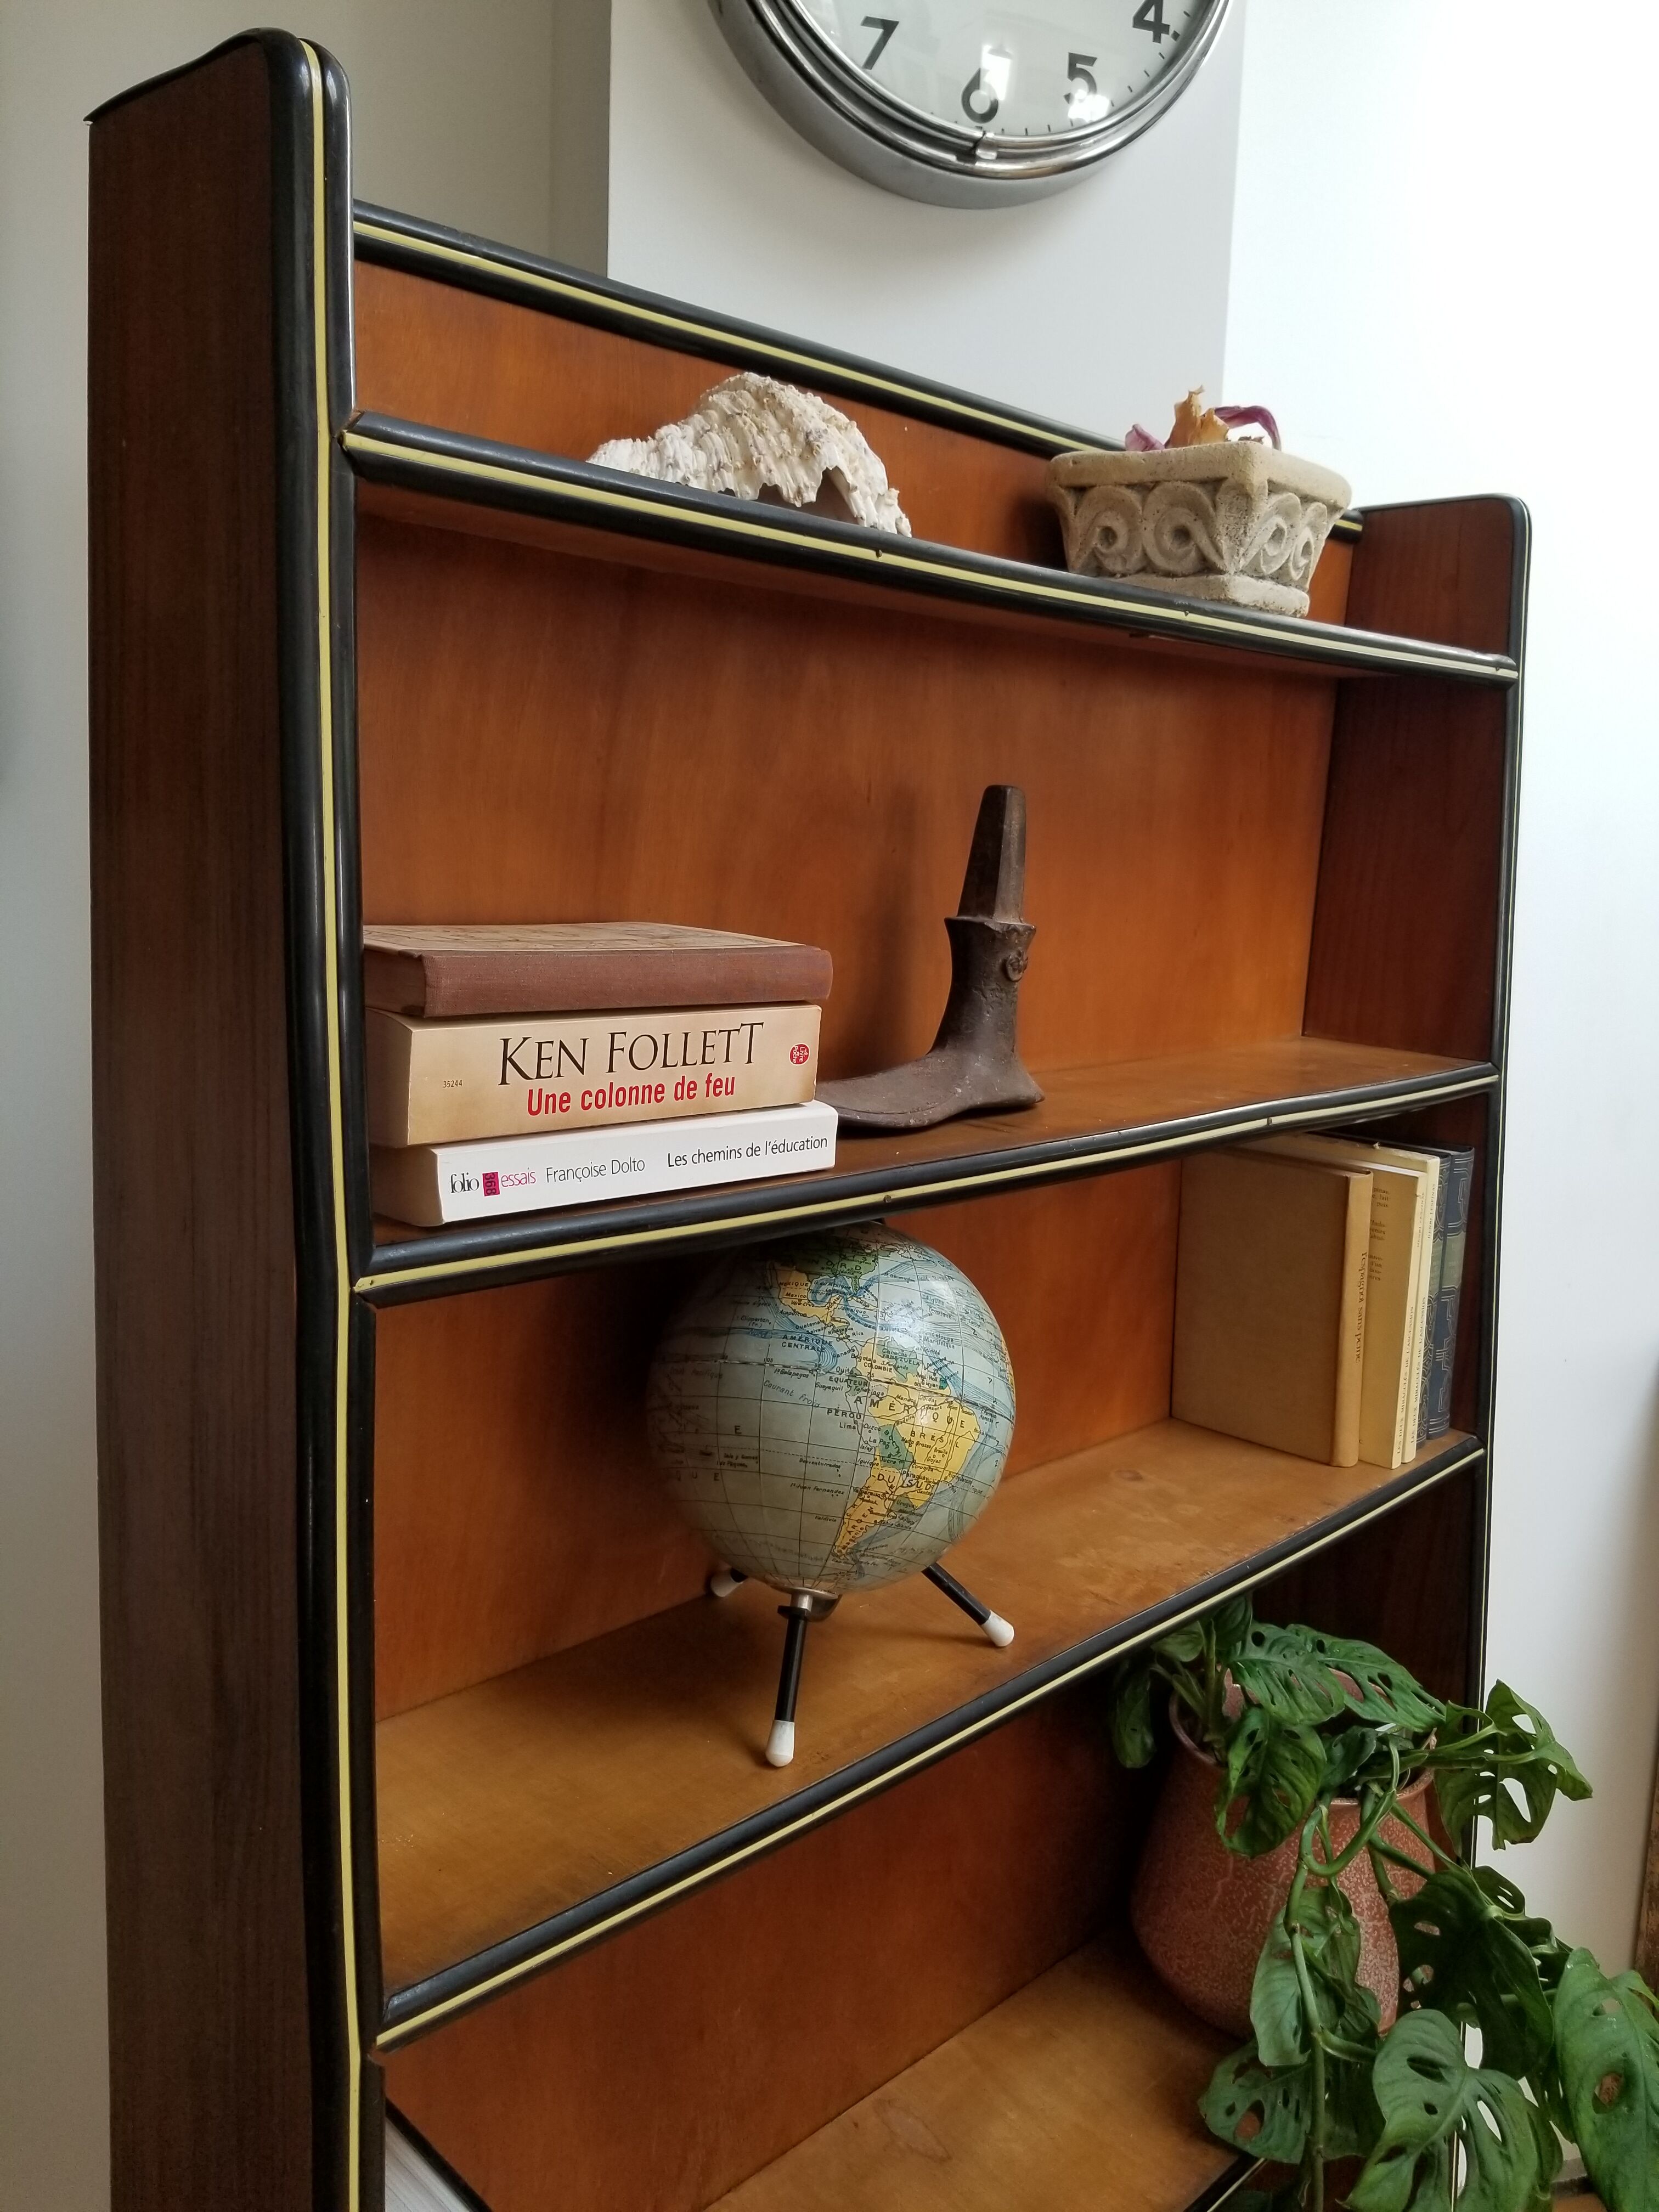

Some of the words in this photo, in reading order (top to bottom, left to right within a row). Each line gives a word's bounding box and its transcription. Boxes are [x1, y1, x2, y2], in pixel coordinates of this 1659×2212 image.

[1132, 0, 1170, 44] 4
[860, 15, 900, 70] 7
[1063, 52, 1098, 104] 5
[961, 67, 998, 124] 6
[497, 1036, 590, 1086] KEN
[605, 1022, 764, 1074] FOLLETT
[443, 1079, 463, 1088] 35244
[528, 1087, 571, 1116] Une
[580, 1082, 665, 1111] colonne
[674, 1075, 697, 1101] de
[706, 1071, 735, 1097] feu
[667, 1153, 687, 1167] Les
[691, 1146, 742, 1165] chemins
[746, 1142, 761, 1158] de
[765, 1136, 827, 1156] l'éducation
[546, 1161, 606, 1183] Françoise
[611, 1156, 645, 1175] Dolto
[449, 1172, 479, 1194] folio
[484, 1173, 497, 1195] 368
[501, 1167, 537, 1188] essais
[1357, 1251, 1368, 1304] l'espagnol
[1355, 1306, 1363, 1331] sans
[781, 1341, 826, 1352] CENTRALE
[782, 1334, 833, 1346] AMÉRIQUE
[864, 1362, 893, 1373] COLOMBIE
[764, 1380, 794, 1396] Courant
[815, 1381, 844, 1392] Guayaquil
[829, 1375, 868, 1387] EQUATEUR
[827, 1406, 861, 1420] PÉROU
[839, 1421, 856, 1430] Lima
[864, 1423, 881, 1431] Cuzco
[879, 1438, 890, 1446] Paz
[910, 1430, 959, 1448] BRÉSIL
[916, 1441, 932, 1449] Grosso
[857, 1457, 879, 1467] Iquique
[813, 1485, 845, 1495] Fernandez
[877, 1473, 896, 1483] DU
[906, 1479, 932, 1491] SUD
